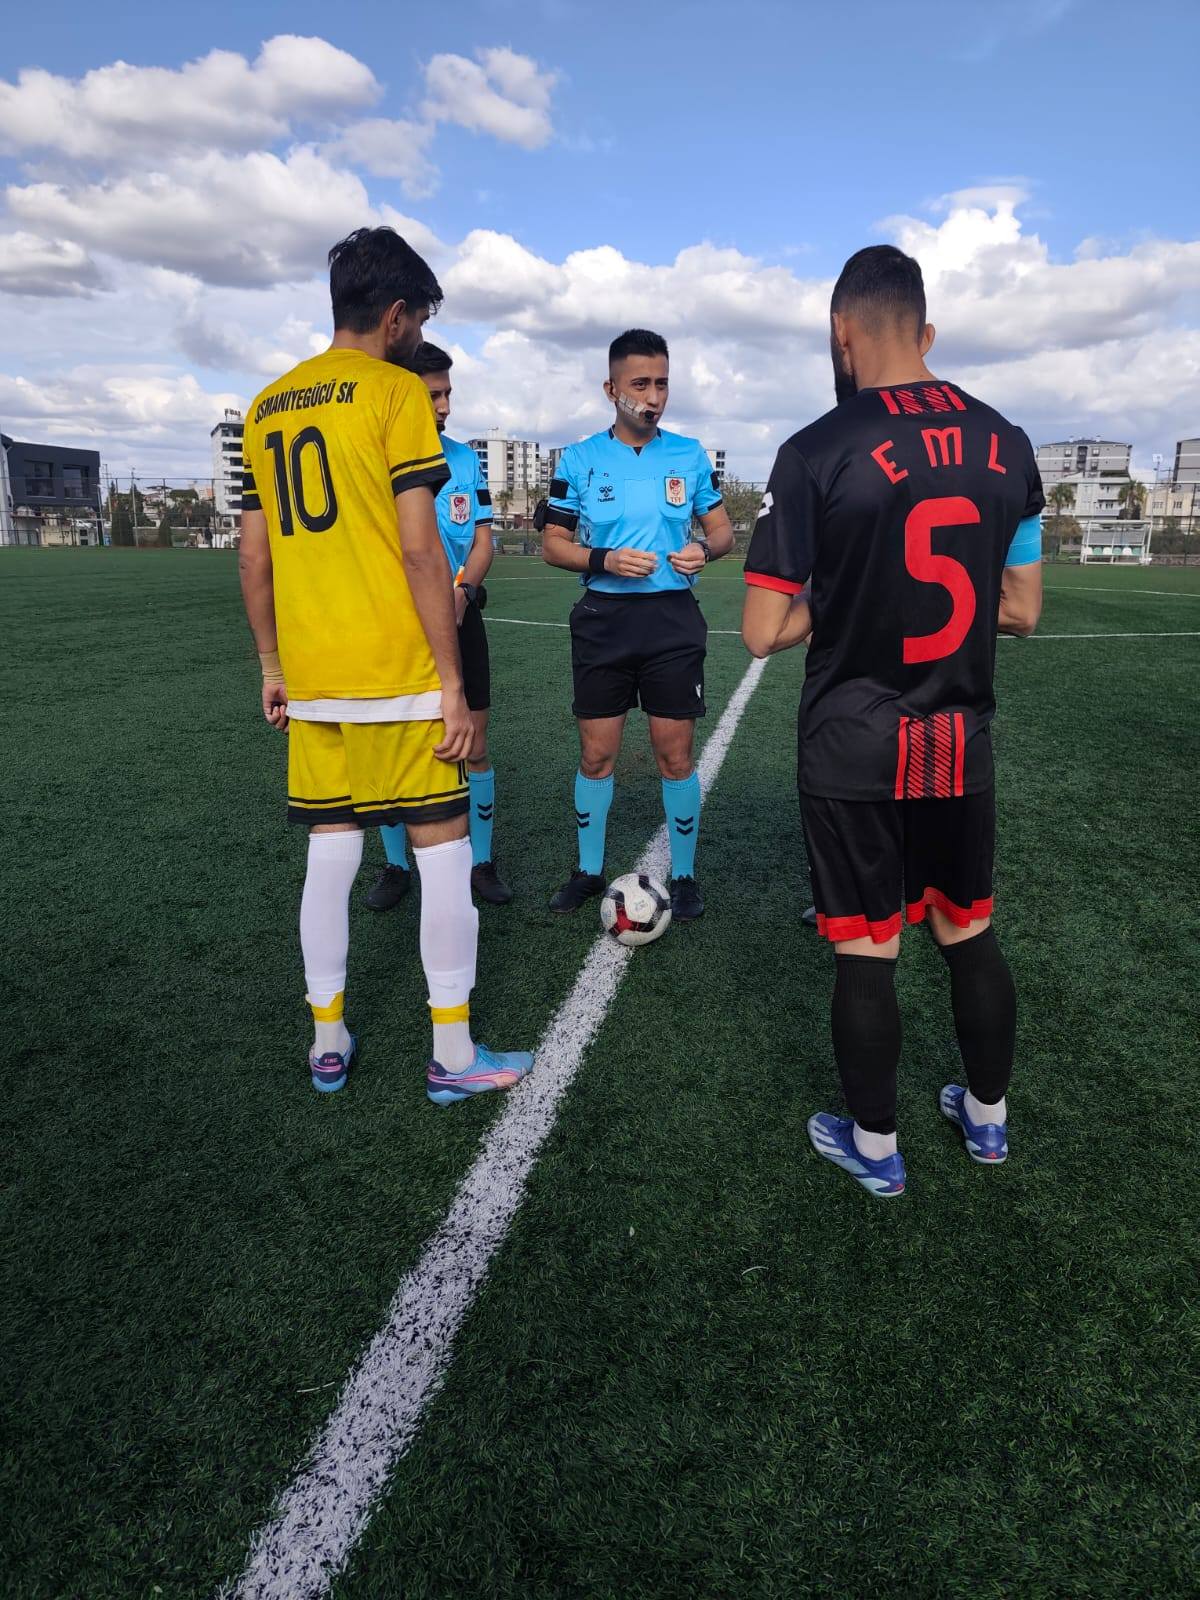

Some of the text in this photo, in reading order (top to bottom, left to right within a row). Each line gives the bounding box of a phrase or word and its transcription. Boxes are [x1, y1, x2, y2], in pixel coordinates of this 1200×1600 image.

[336, 382, 358, 404] SK
[264, 426, 338, 536] 10
[902, 495, 981, 664] 5
